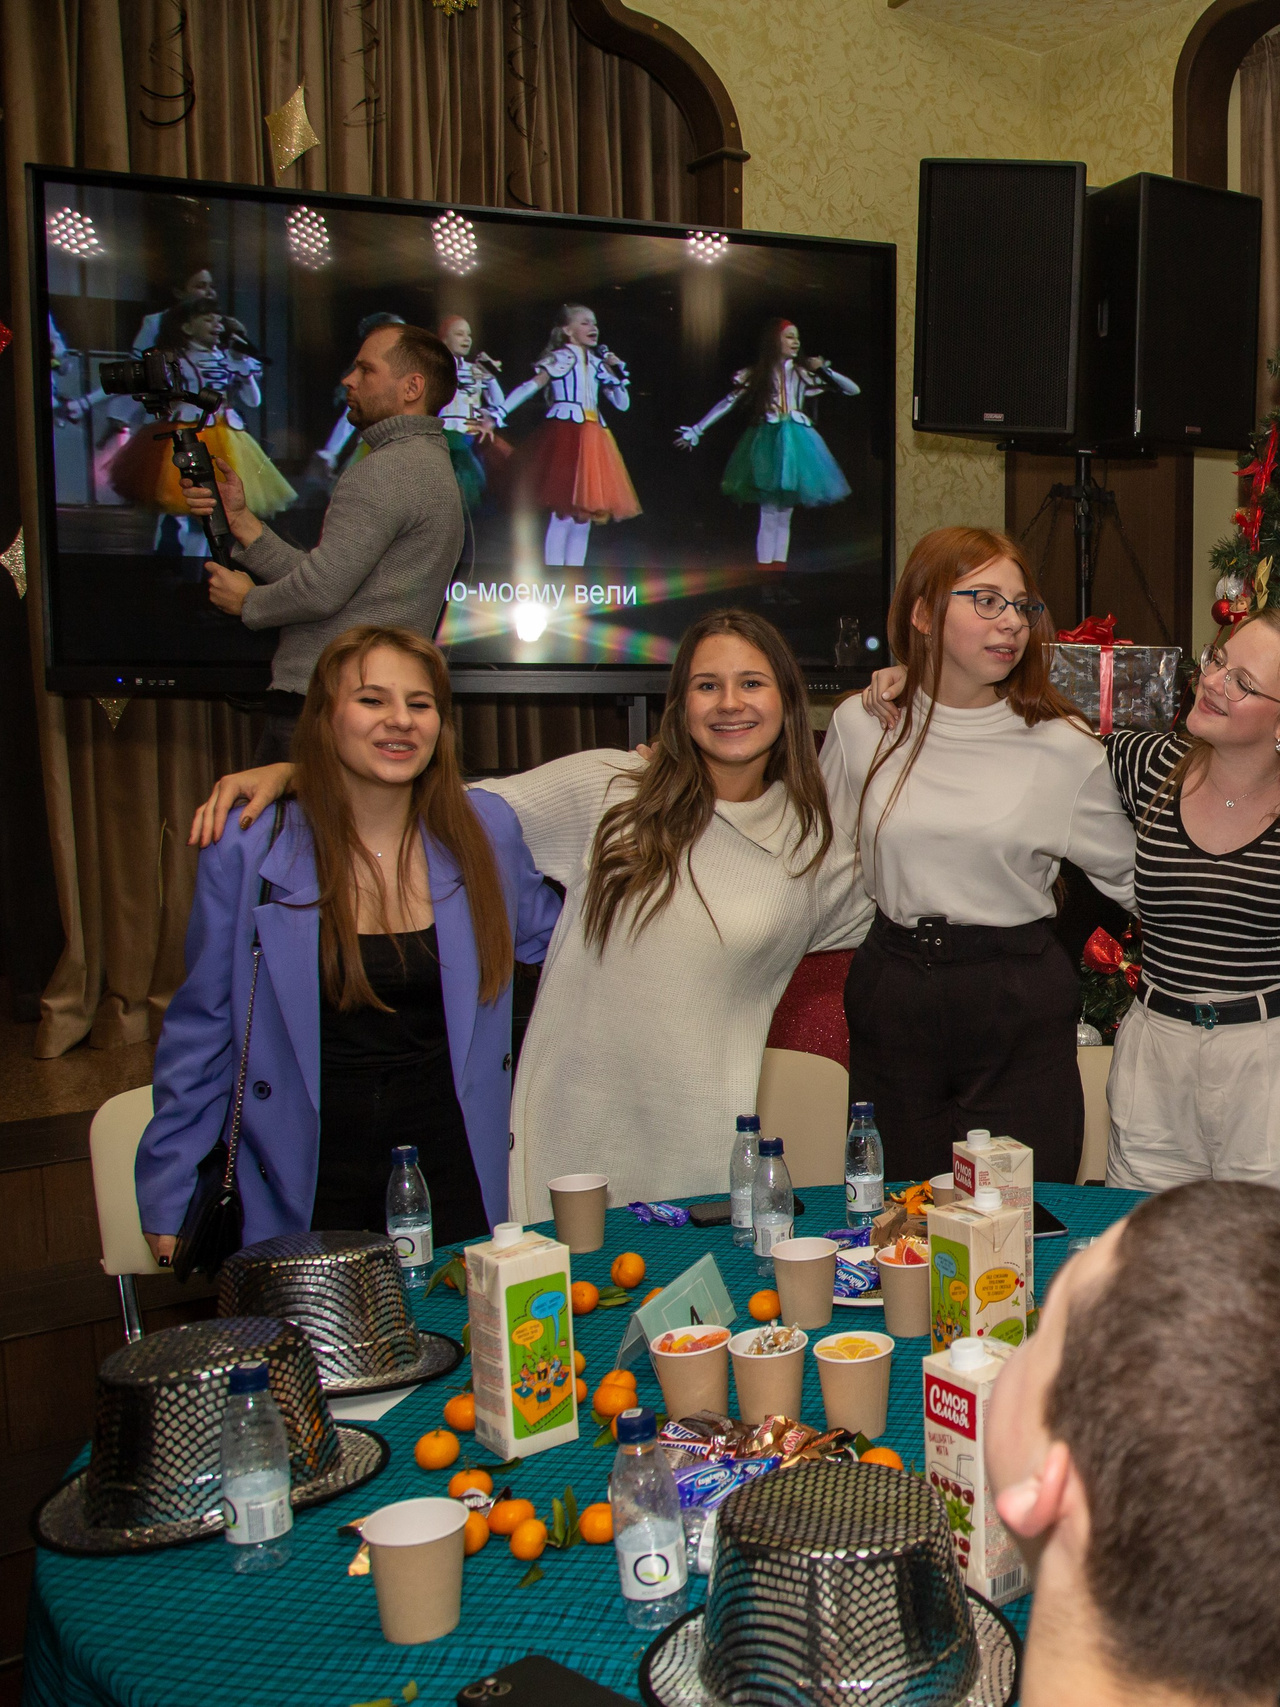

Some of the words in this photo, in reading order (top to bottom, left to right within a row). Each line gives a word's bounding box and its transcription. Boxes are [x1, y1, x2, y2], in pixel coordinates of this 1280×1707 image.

[574, 584, 637, 605] вели
[959, 1164, 972, 1179] МОЯ
[929, 1384, 970, 1430] Семья
[941, 1389, 969, 1415] МОЯ
